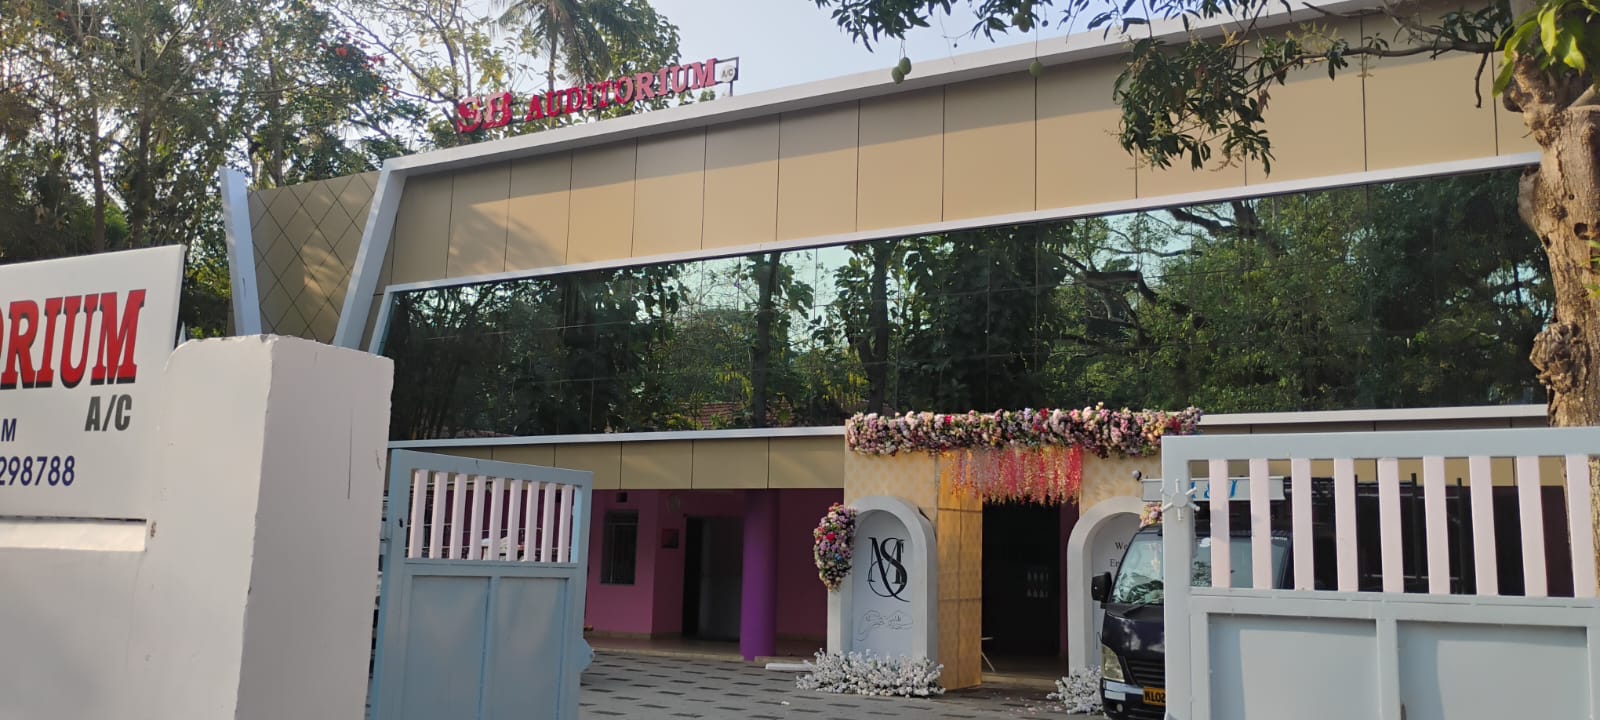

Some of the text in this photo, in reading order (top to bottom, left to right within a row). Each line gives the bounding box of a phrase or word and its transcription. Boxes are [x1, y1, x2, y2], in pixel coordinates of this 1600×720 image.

[456, 58, 718, 133] SB AUDITORIUM
[0, 288, 146, 390] RIUM
[84, 393, 133, 432] A/C
